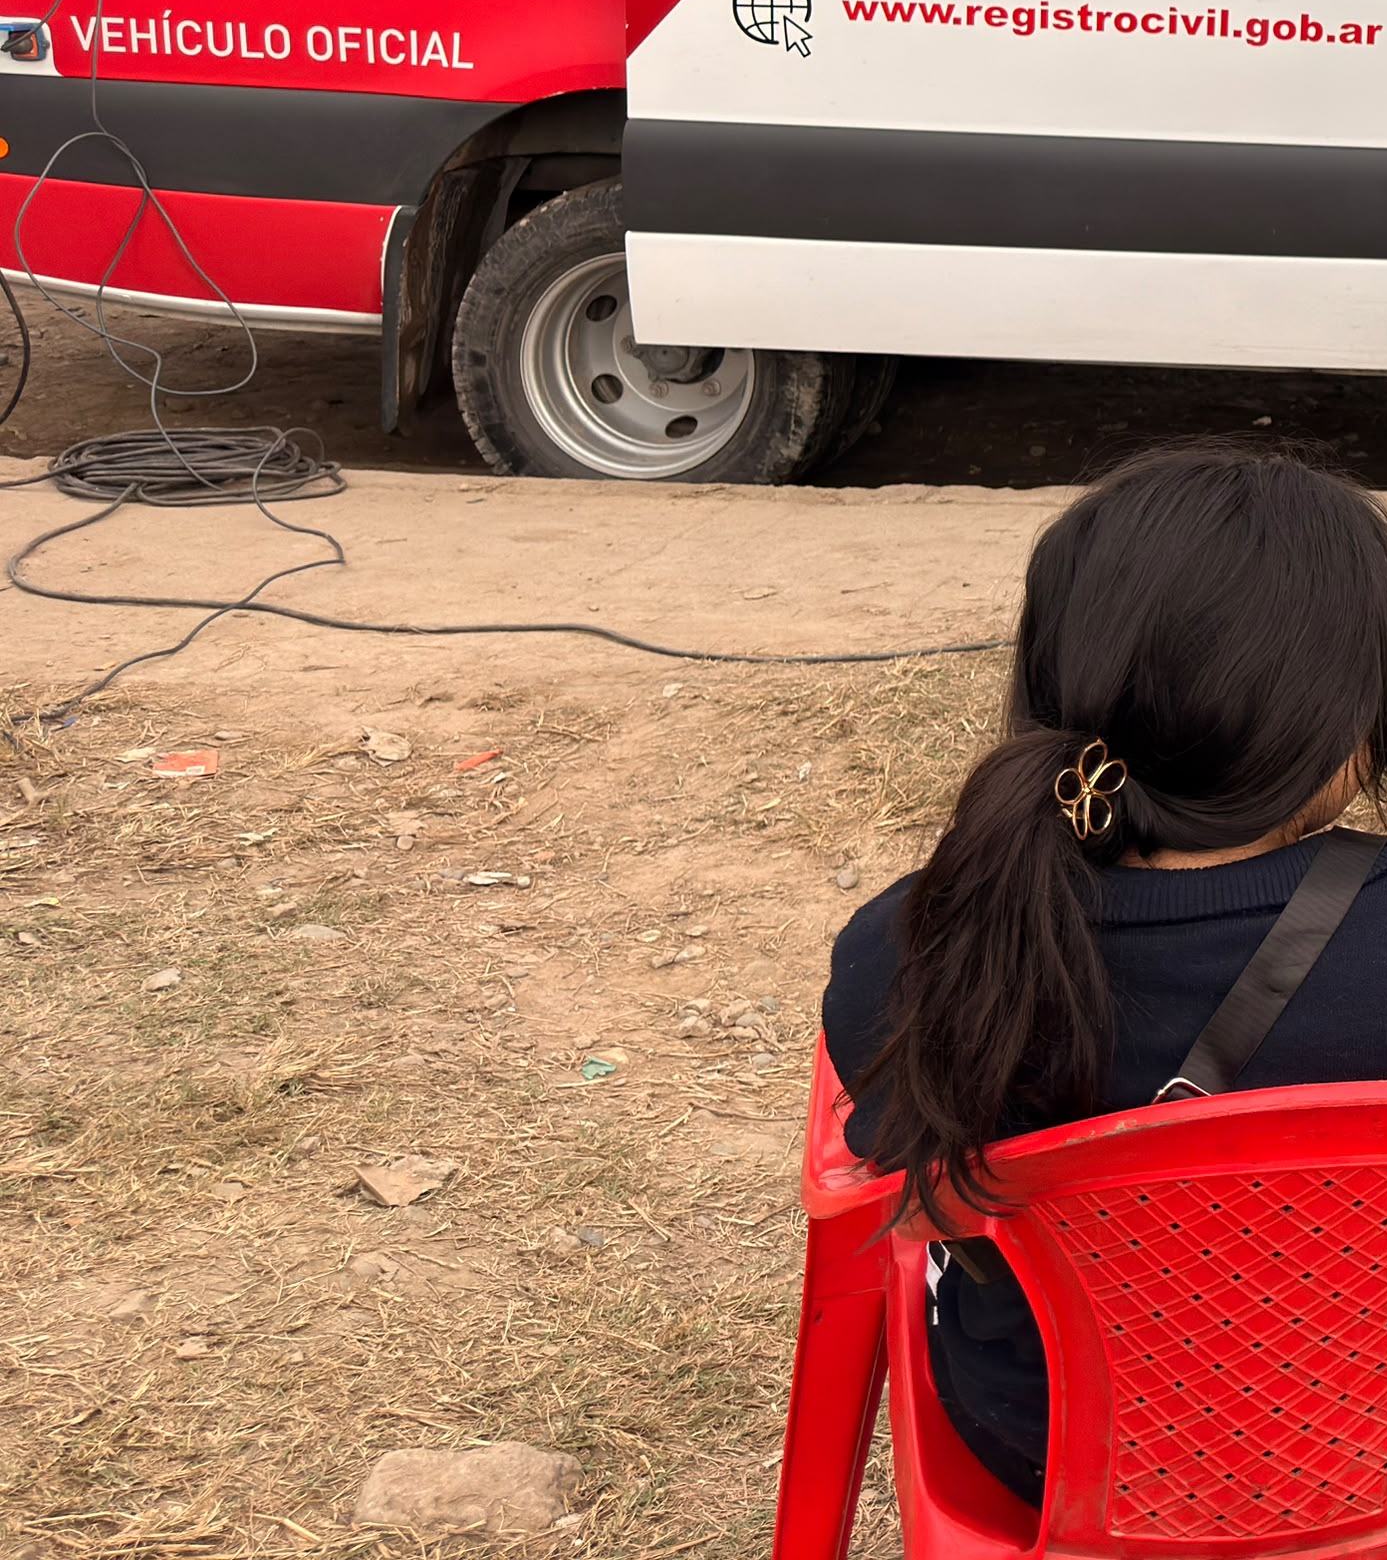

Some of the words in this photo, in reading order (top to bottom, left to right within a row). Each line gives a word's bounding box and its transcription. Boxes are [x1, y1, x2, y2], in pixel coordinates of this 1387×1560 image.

[71, 11, 291, 60] VEHÍCULO
[307, 26, 475, 69] OFICIAL
[842, 0, 1383, 48] www.registrocivil.gob.ar
